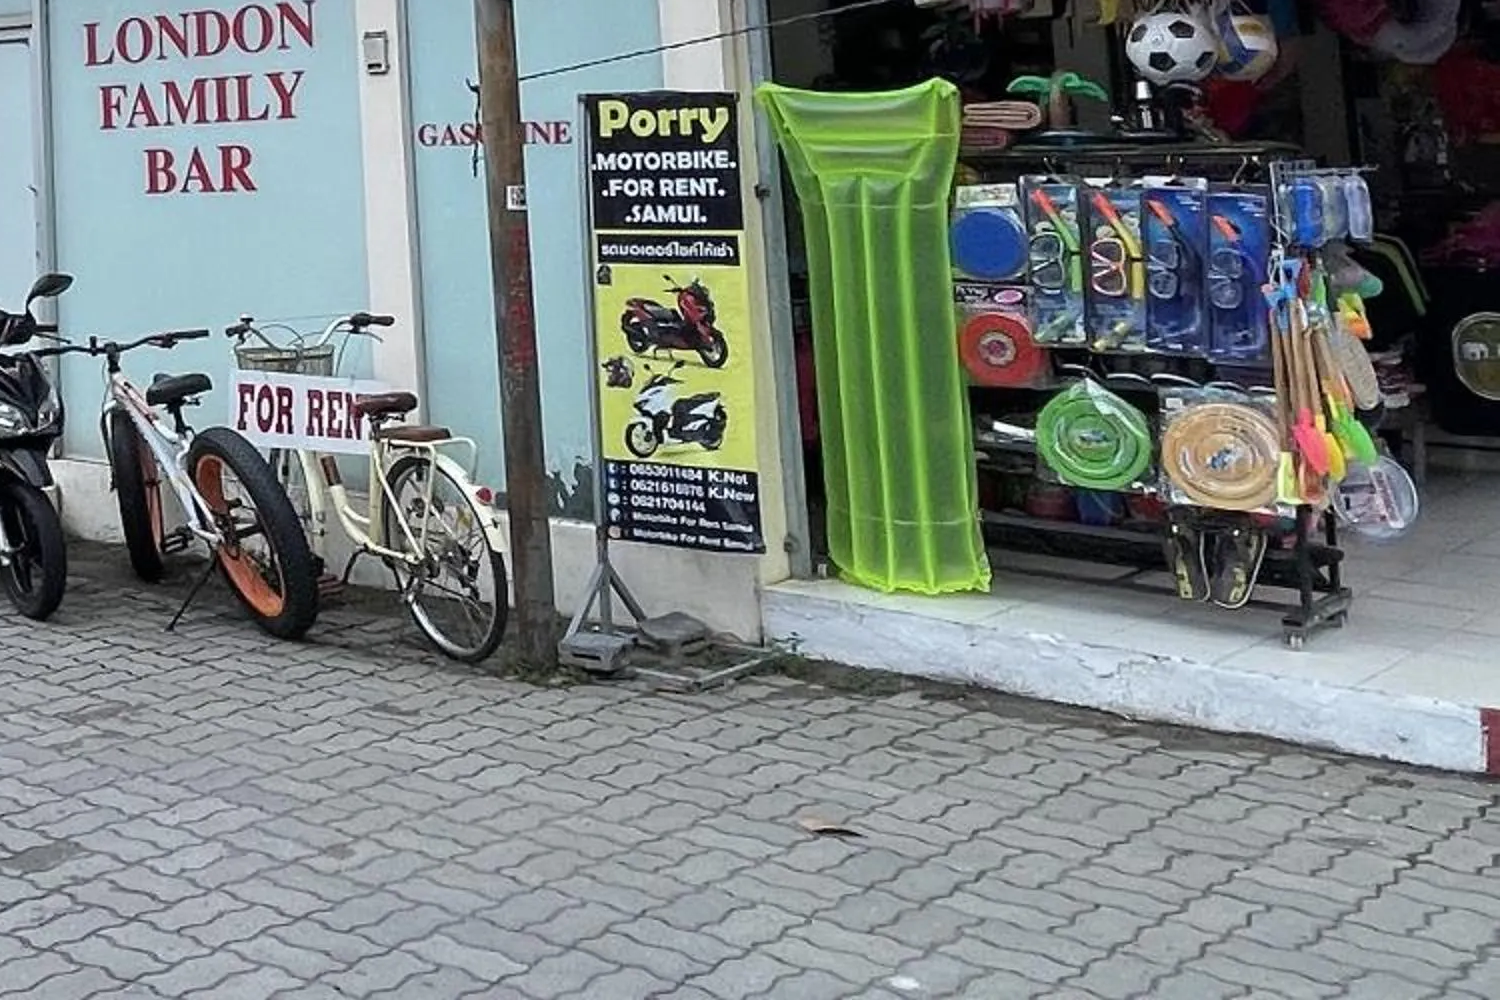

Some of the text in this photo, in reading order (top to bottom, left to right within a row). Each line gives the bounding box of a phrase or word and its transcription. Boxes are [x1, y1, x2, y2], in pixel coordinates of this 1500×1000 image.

[83, 0, 316, 67] LONDON
[99, 70, 305, 130] FAMILY
[598, 100, 729, 143] Porry
[143, 144, 258, 194] BAR
[237, 383, 365, 441] FOR REN
